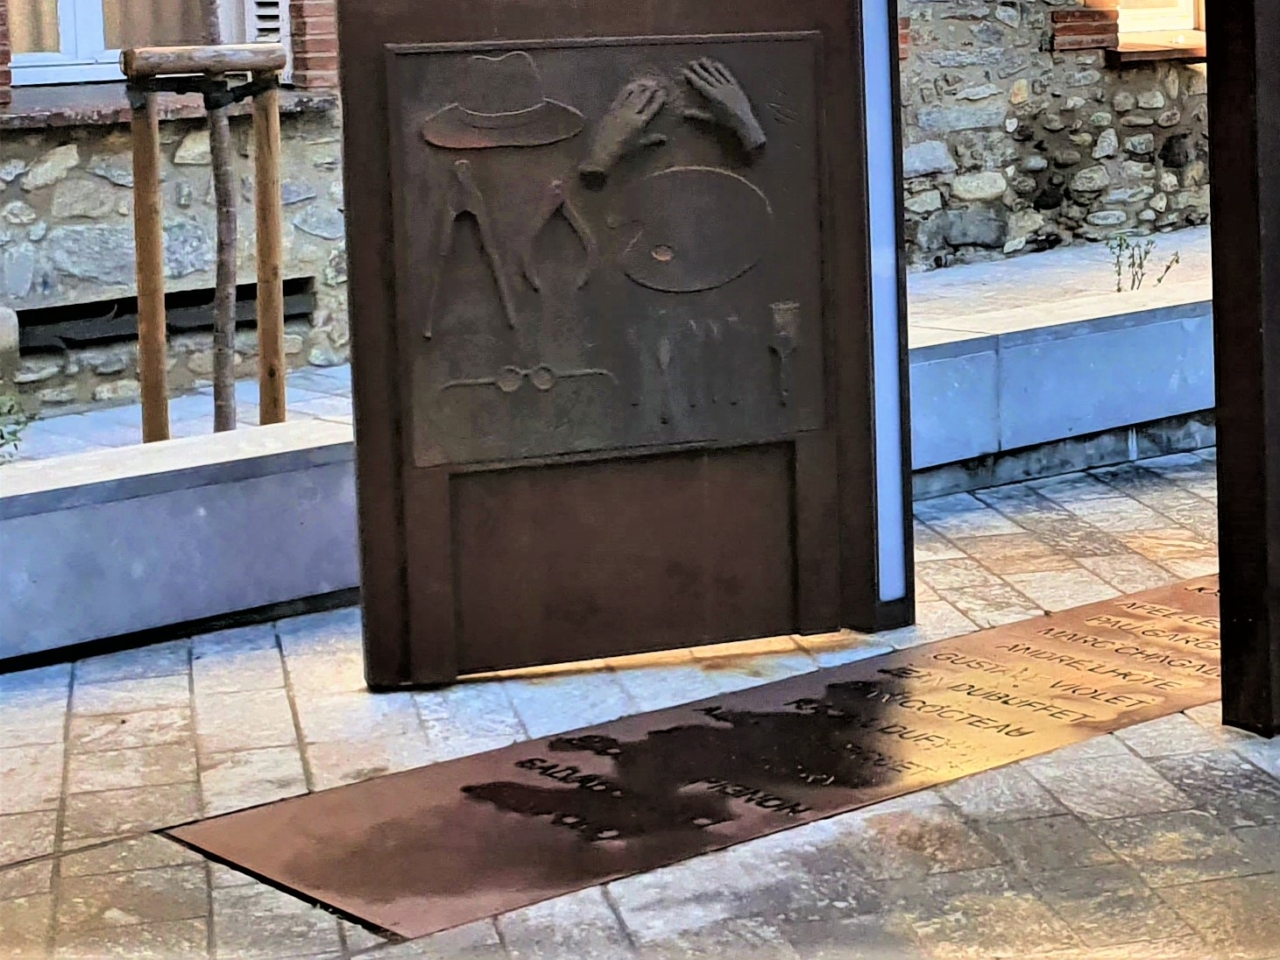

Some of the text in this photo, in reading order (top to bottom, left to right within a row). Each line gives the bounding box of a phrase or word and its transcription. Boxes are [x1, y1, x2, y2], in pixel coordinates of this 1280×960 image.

[1037, 626, 1117, 650] MARC
[946, 682, 1097, 723] DUBUFFET
[1049, 679, 1151, 708] VIOLET
[897, 698, 1037, 738] COCTEAU
